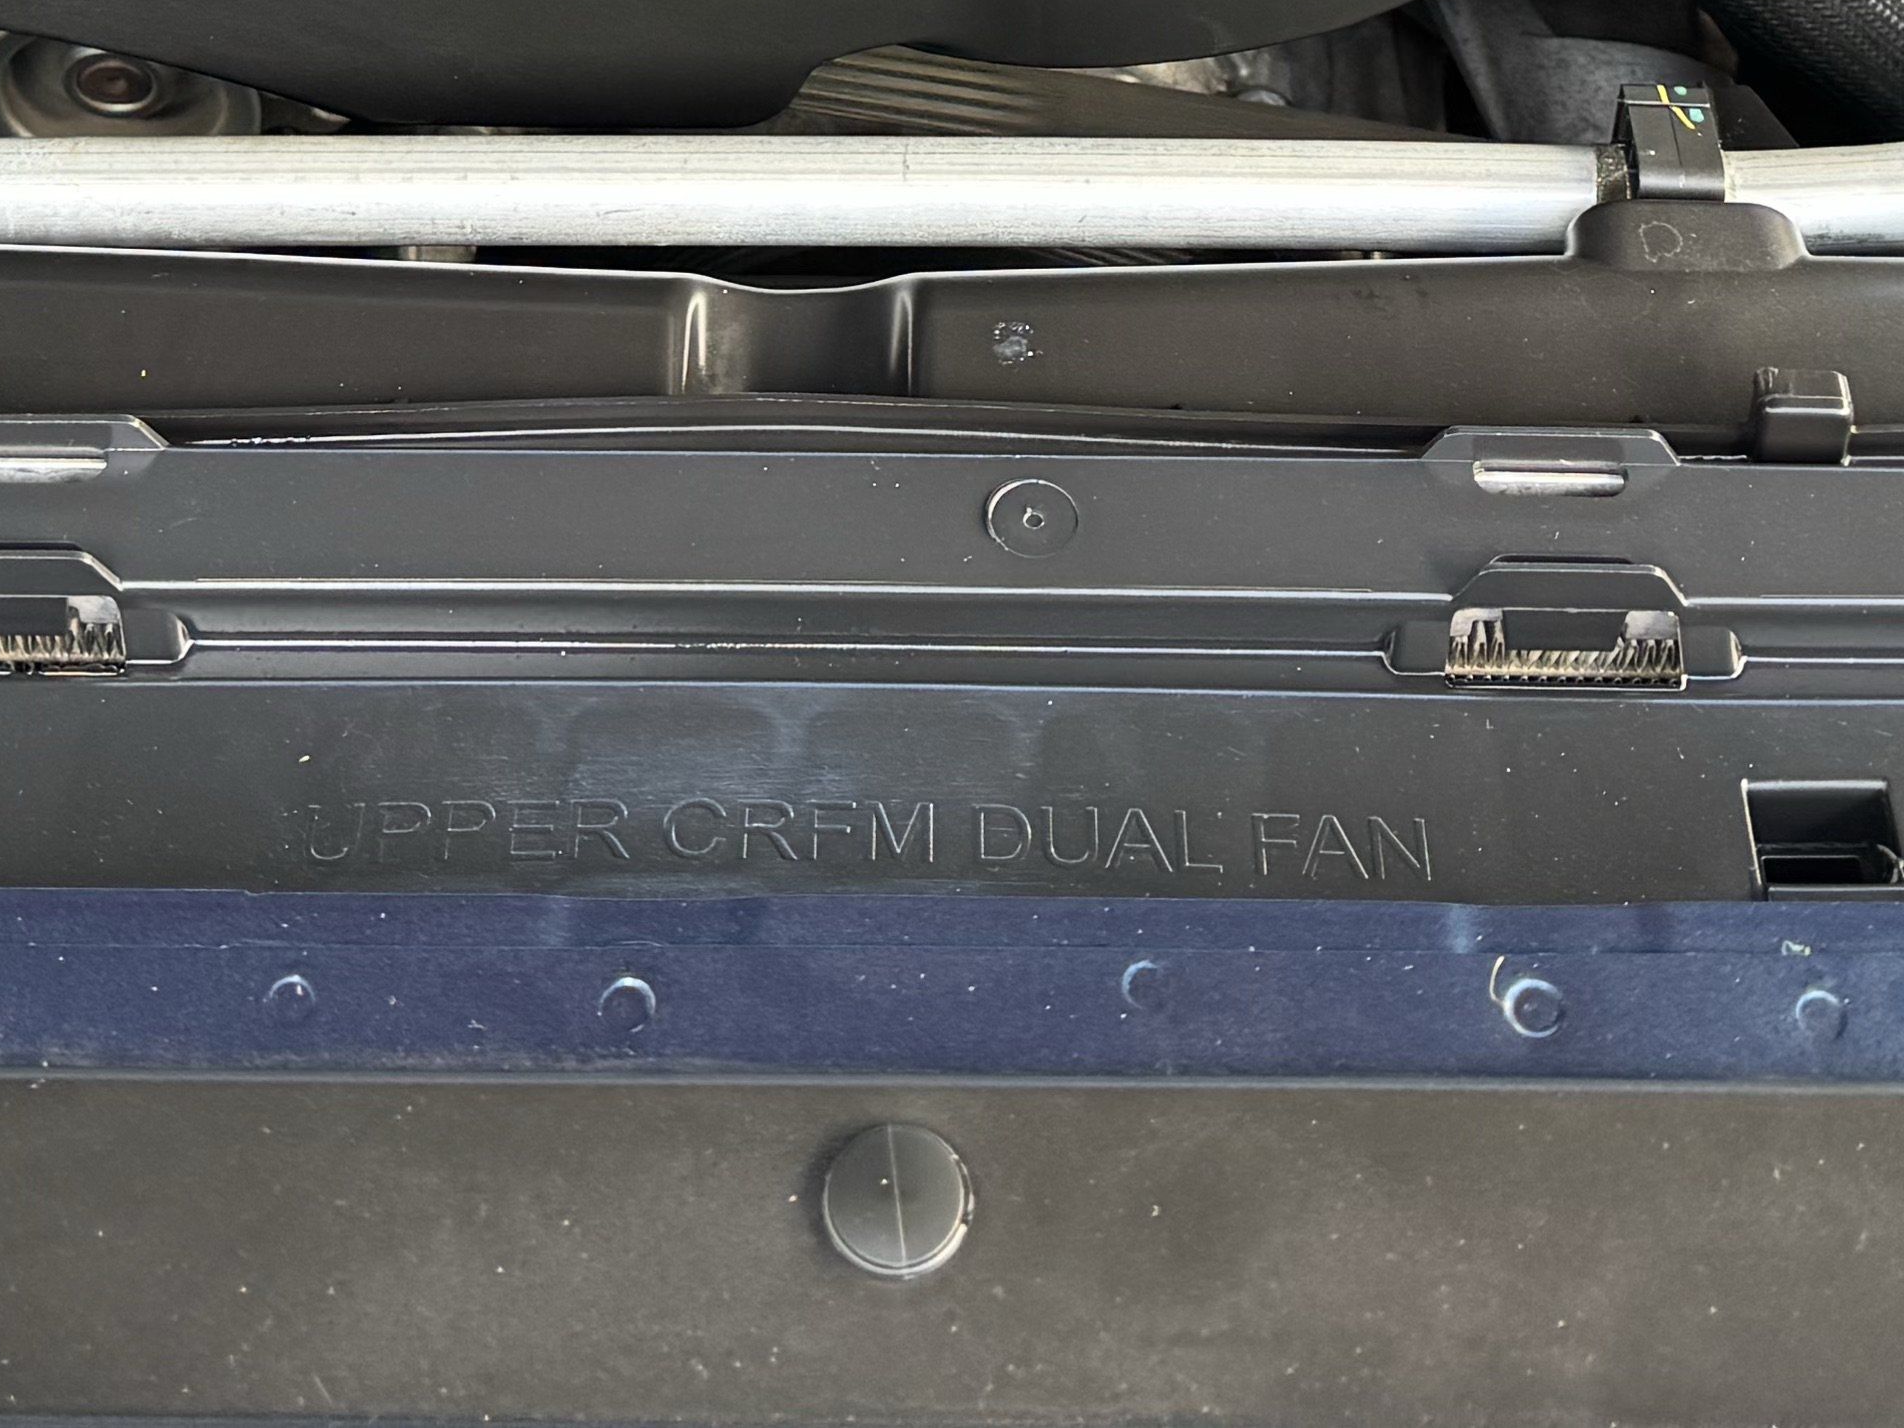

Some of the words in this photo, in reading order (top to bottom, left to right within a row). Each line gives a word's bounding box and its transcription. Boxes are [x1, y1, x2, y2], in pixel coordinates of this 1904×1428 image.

[306, 799, 632, 861] UPPER
[661, 797, 935, 864] CRFM
[973, 802, 1224, 874] DUAL
[1251, 811, 1433, 882] FAN
